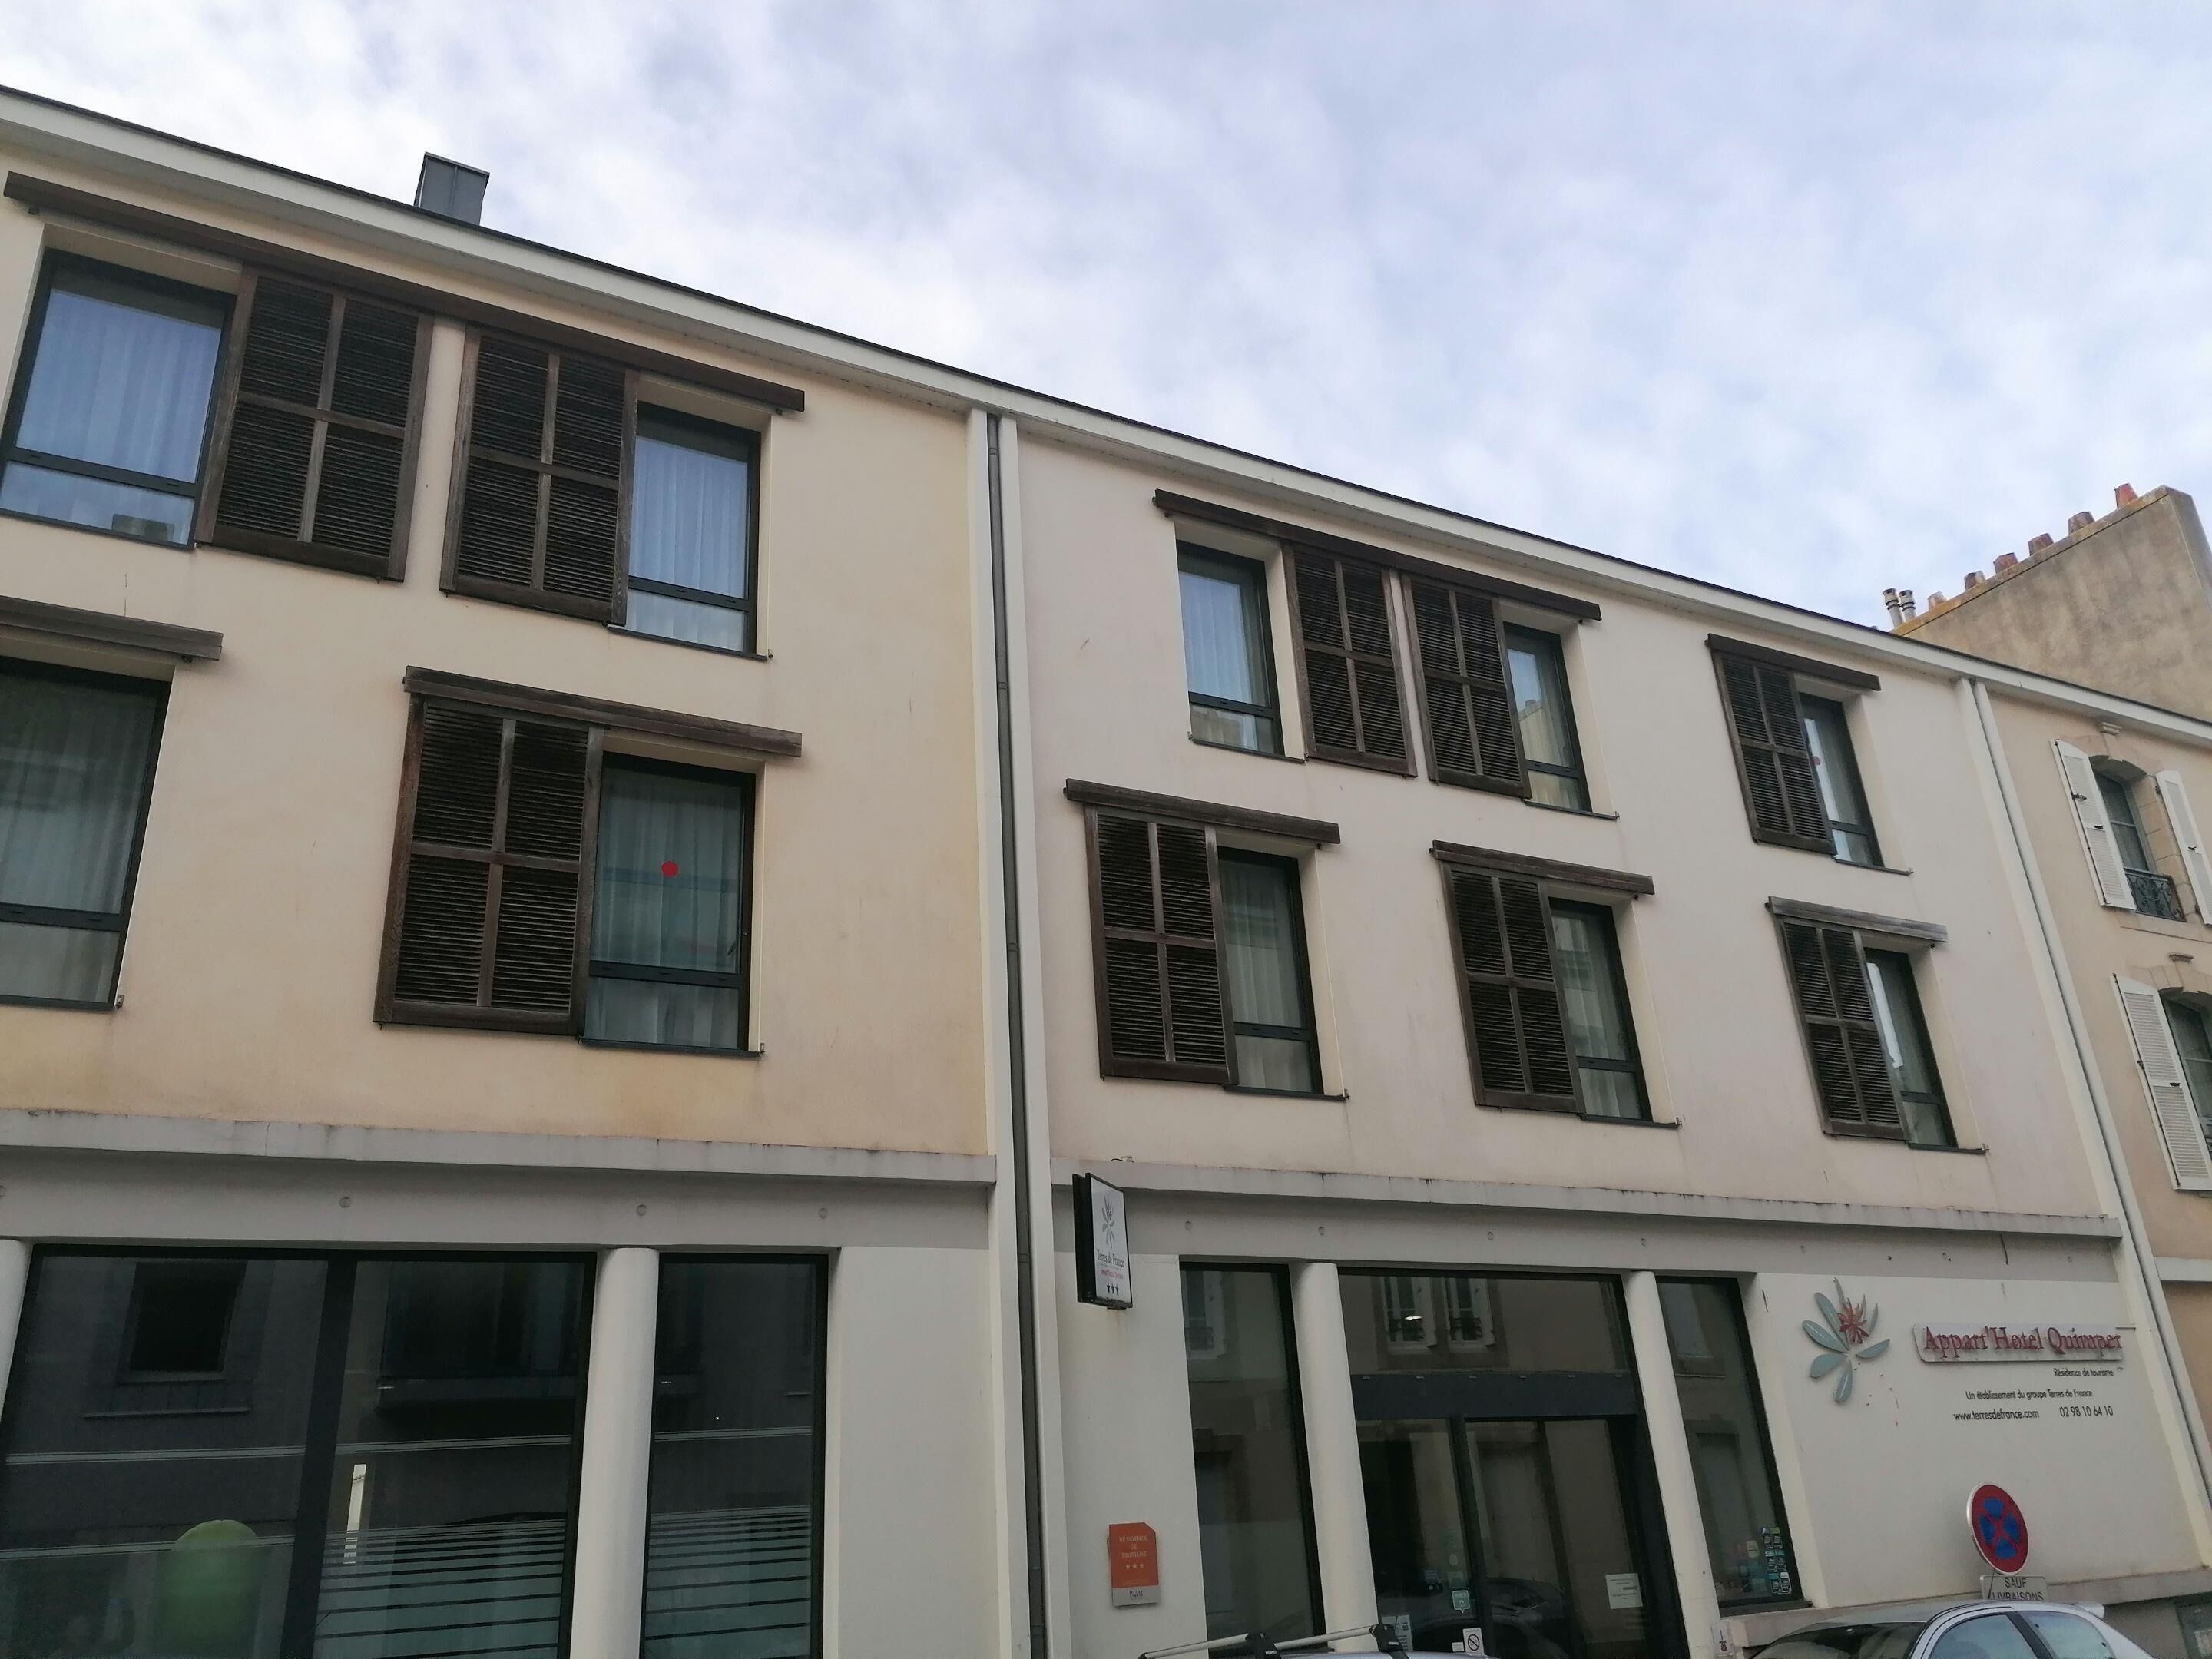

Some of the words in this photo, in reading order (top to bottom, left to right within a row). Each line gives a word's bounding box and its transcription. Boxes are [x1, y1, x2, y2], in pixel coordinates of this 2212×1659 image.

[1108, 1253, 1113, 1264] de
[2047, 1327, 2122, 1356] Quimper
[2053, 1367, 2081, 1376] Résidence
[2082, 1367, 2090, 1376] de
[2090, 1368, 2114, 1376] tourisme
[1965, 1390, 1975, 1399] Un
[1976, 1390, 2015, 1399] établissement
[2017, 1389, 2025, 1398] du
[2026, 1392, 2047, 1400] groupe
[2047, 1389, 2065, 1398] Terres
[2065, 1389, 2073, 1398] de
[2073, 1389, 2093, 1397] France
[1953, 1408, 2040, 1421] www.terresdefrance.com
[2059, 1406, 2070, 1417] 02
[2070, 1406, 2081, 1417] 98
[2081, 1406, 2091, 1416] 10
[2093, 1406, 2102, 1416] 64
[2103, 1406, 2114, 1416] 10
[2004, 1577, 2027, 1588] SAUF
[1992, 1591, 2045, 1601] LIVRAISONS
